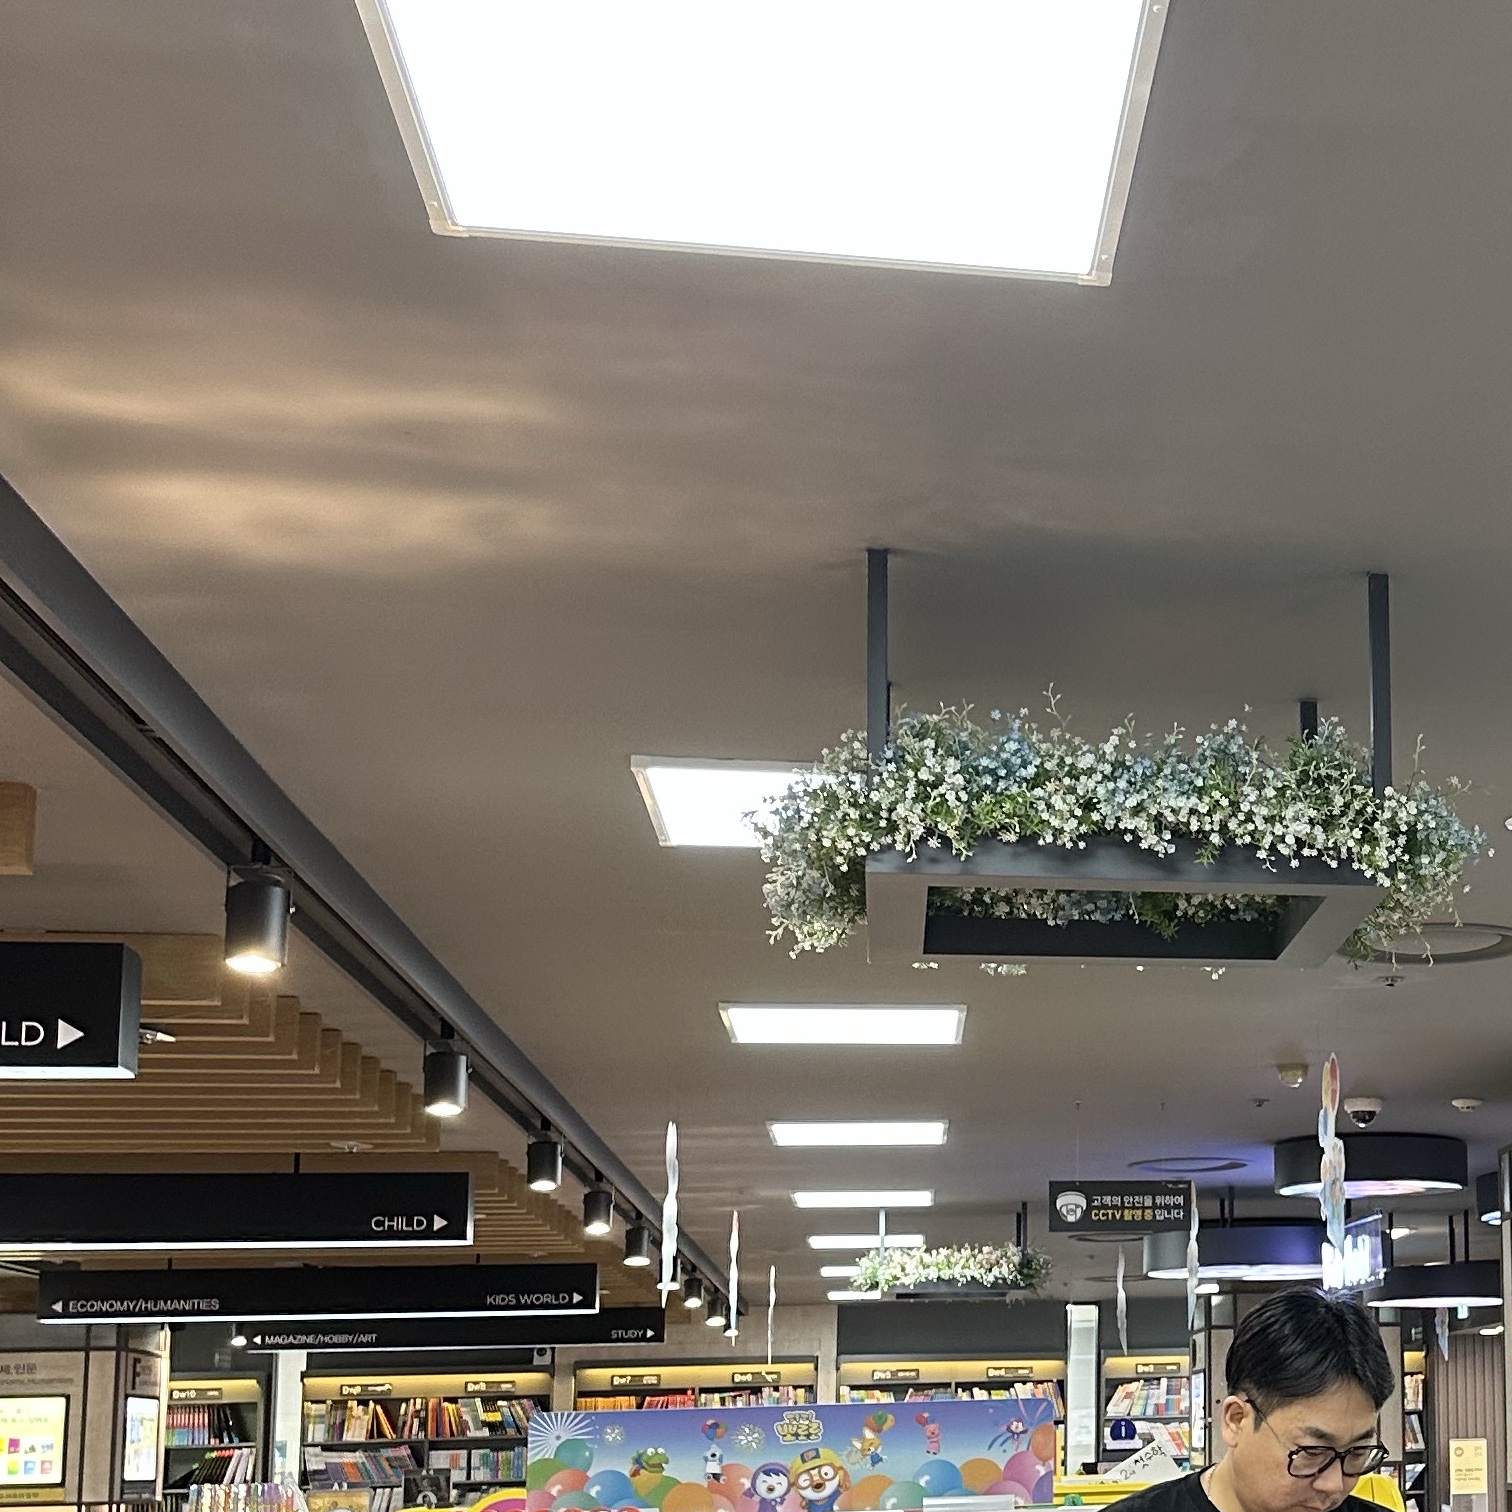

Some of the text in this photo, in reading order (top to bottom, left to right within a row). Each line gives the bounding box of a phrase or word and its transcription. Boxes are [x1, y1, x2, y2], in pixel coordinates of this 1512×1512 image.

[1091, 1195, 1184, 1207] 고객의 안전을 위하여
[1091, 1209, 1122, 1221] CCTV
[1143, 1209, 1153, 1221] 중
[1155, 1209, 1185, 1221] 입니다
[371, 1215, 427, 1231] CHILD
[486, 1292, 570, 1306] KIDS WORLD
[68, 1298, 220, 1314] ECONOMY/HUMANITIES
[265, 1333, 378, 1345] MAGAZINE/HOBBY/ART
[610, 1329, 644, 1340] STUDY
